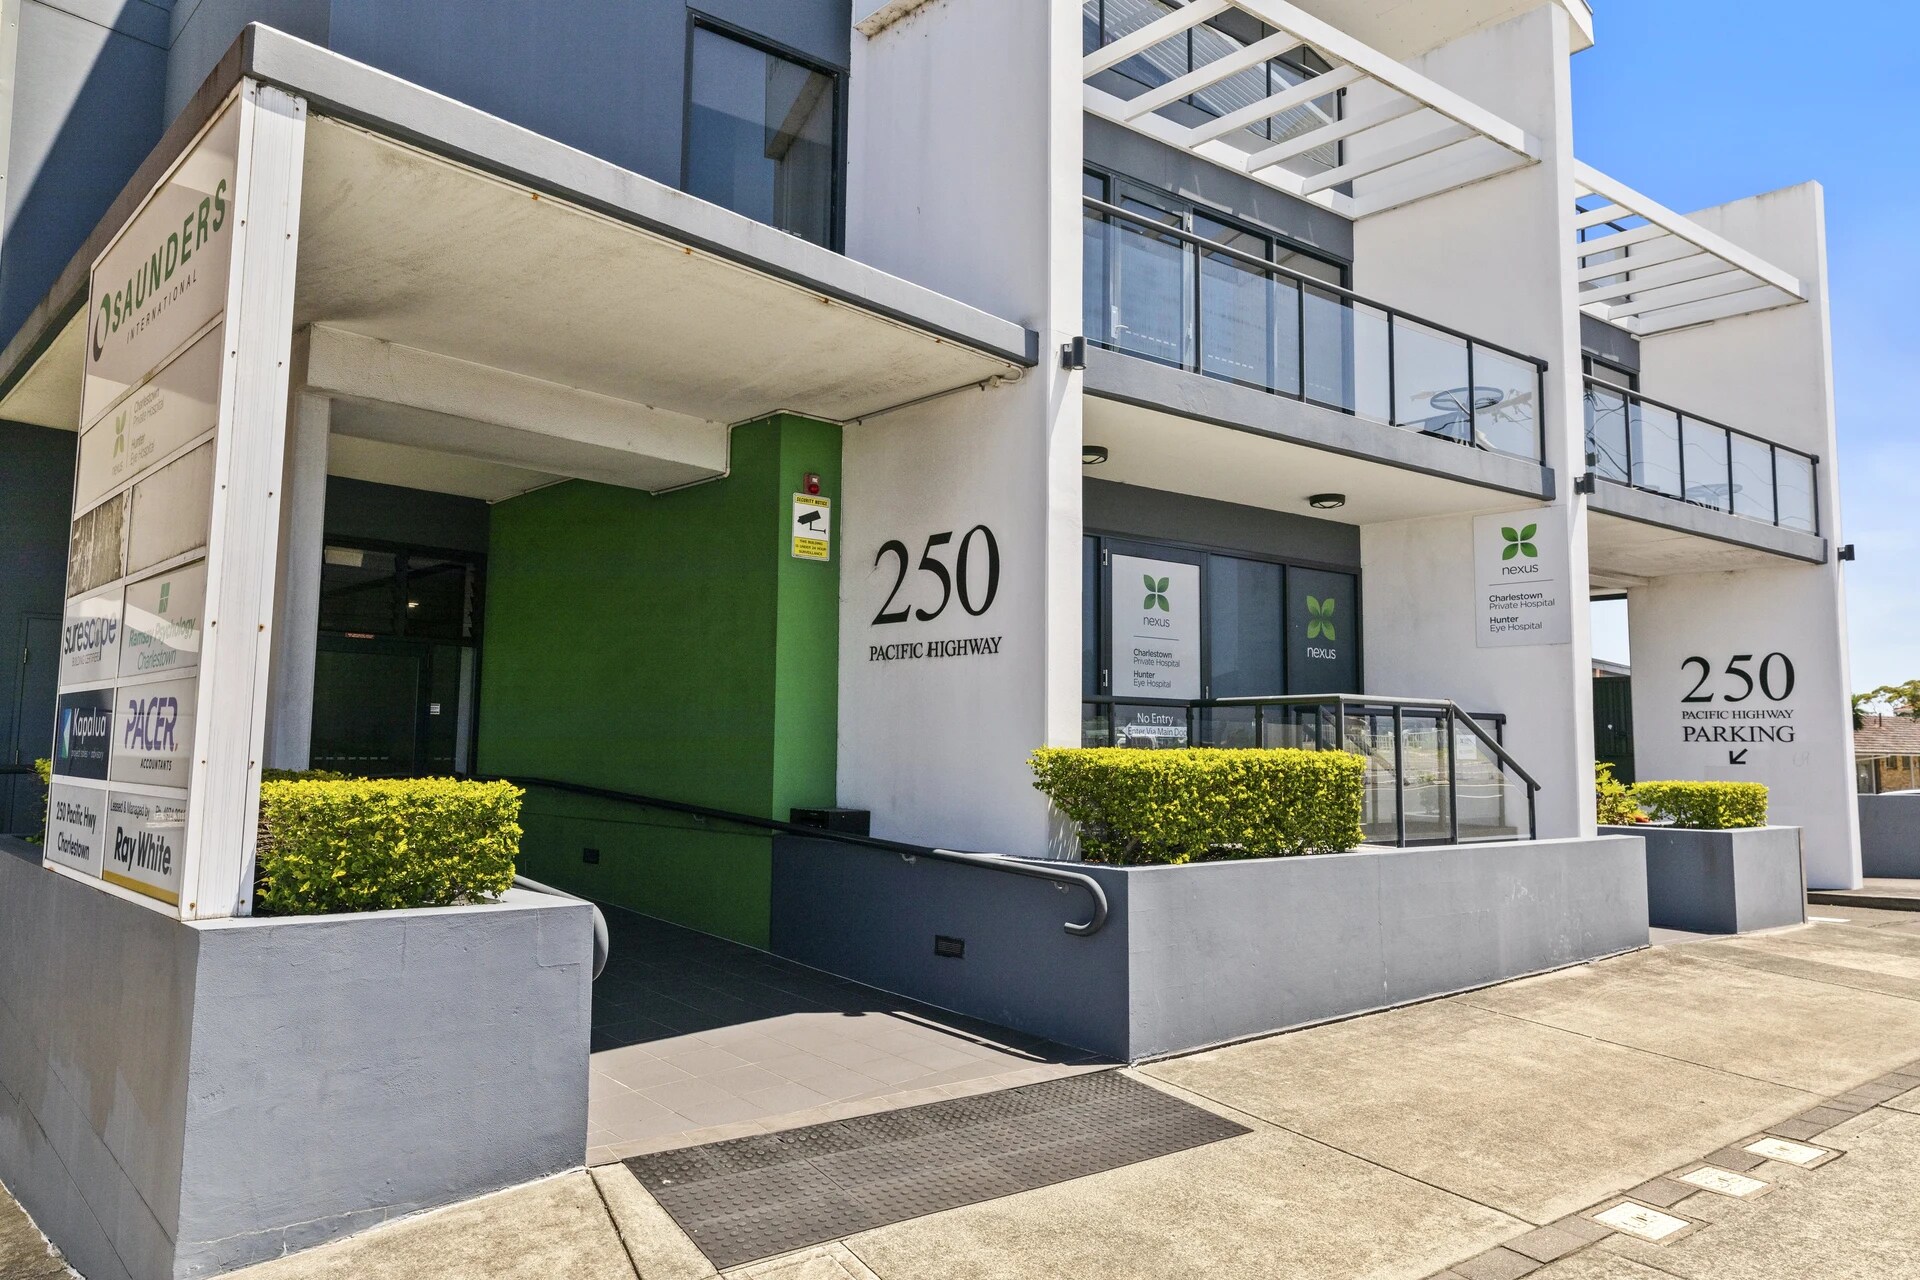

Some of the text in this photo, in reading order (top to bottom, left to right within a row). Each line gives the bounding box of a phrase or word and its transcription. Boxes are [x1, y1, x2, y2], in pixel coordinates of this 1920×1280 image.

[112, 178, 227, 333] SAUNDERS
[126, 268, 198, 344] INTERNATIONAL
[871, 524, 1001, 626] 250
[1501, 564, 1539, 575] nexus
[1488, 592, 1543, 603] Charlestown
[1489, 598, 1555, 611] Private Hospital
[1143, 616, 1170, 628] nexus
[1489, 615, 1519, 624] Hunter
[1490, 621, 1543, 633] Eye Hospital
[869, 636, 1003, 662] PACIFIC HIGHWAY
[1133, 648, 1173, 659] Charlestown
[1307, 646, 1337, 660] nexus
[137, 649, 177, 671] Charlestown
[1133, 656, 1181, 669] Private Hospital
[1133, 670, 1155, 679] Hunter
[1680, 652, 1795, 703] 250
[1133, 679, 1172, 689] Eye Hospital
[1137, 712, 1174, 727] No Entry
[1681, 709, 1794, 719] PACIFIC HIGHWAY
[72, 706, 107, 745] Kapalua
[1127, 727, 1187, 737] Enter Via Main Doo
[1682, 725, 1796, 743] PARKING
[140, 758, 173, 771] ACCOUNTANTS
[127, 801, 144, 819] Managed
[56, 801, 97, 835] 250 Pacific Hwy
[57, 831, 90, 860] Charlestown
[113, 826, 137, 872] Ray
